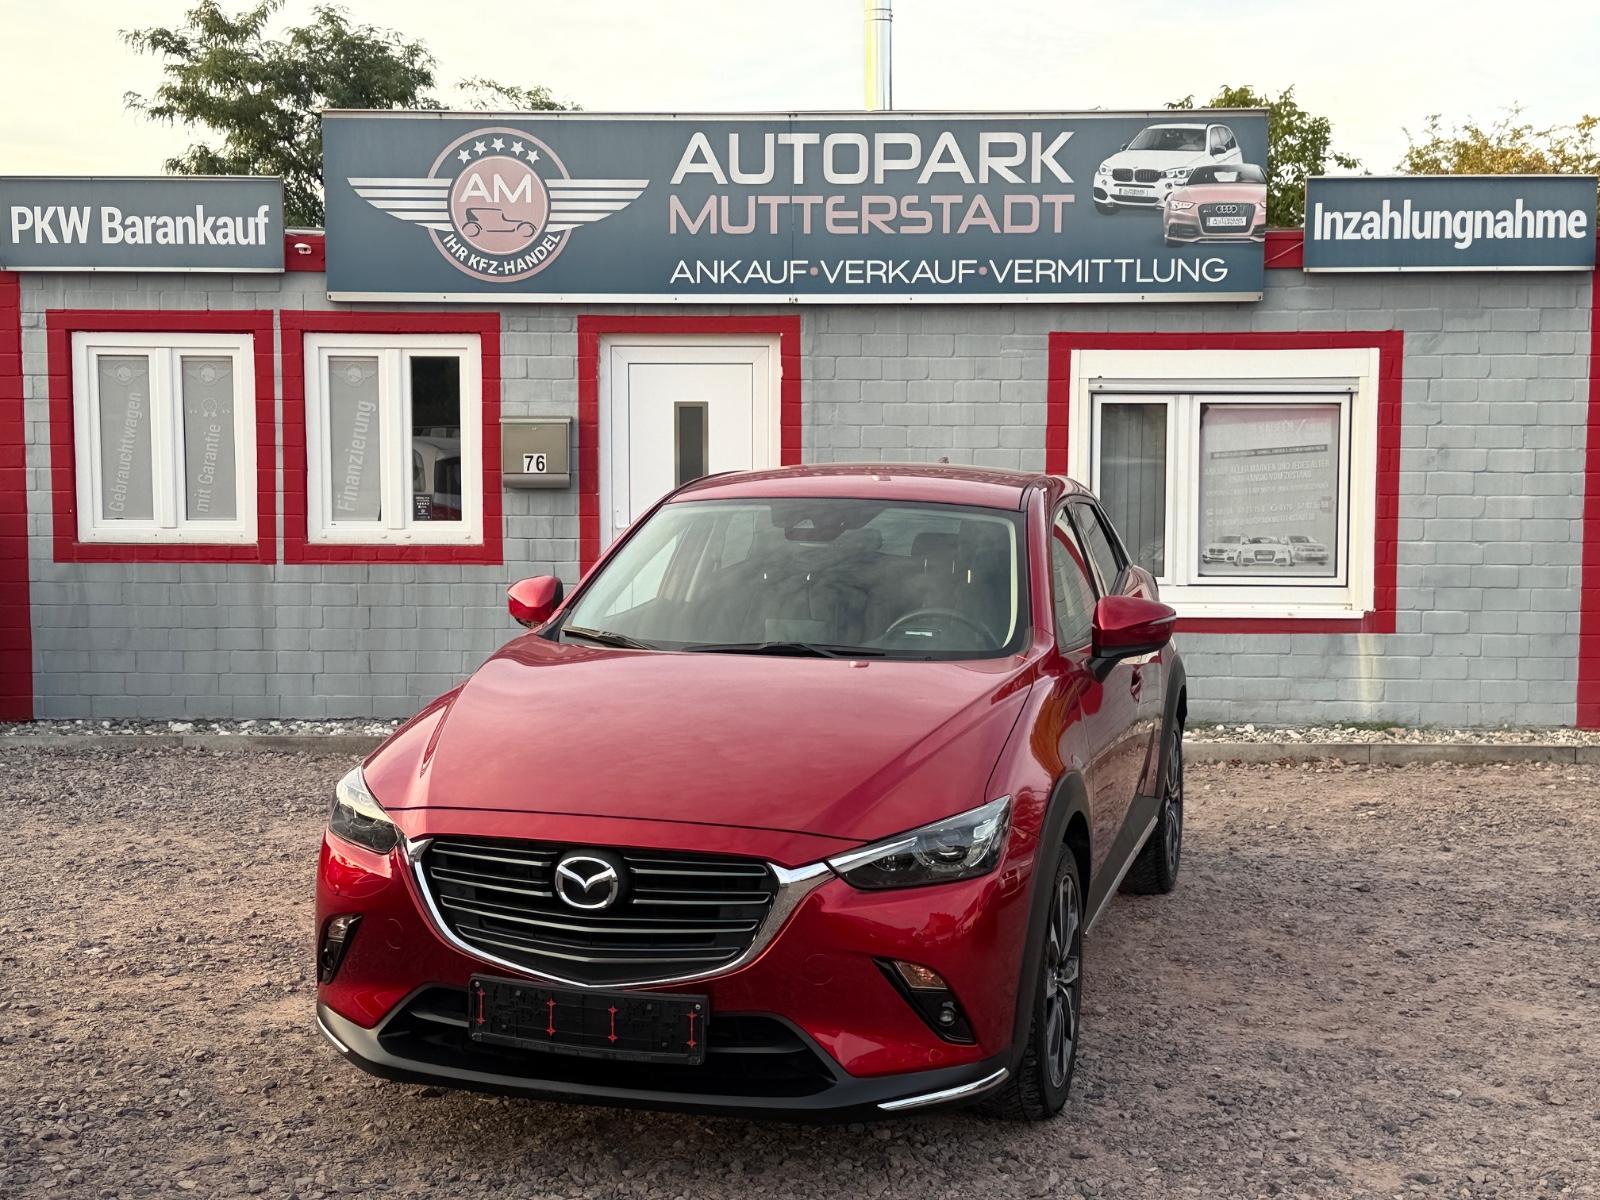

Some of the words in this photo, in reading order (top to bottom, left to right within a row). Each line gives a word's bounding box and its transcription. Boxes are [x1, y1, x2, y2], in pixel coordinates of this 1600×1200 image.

[669, 131, 1075, 185] AUTOPARK
[459, 173, 532, 203] AM
[10, 206, 91, 244] PKW
[101, 204, 269, 245] Barankauf
[669, 194, 1075, 235] MUTTERSTADT
[1313, 198, 1587, 250] Inzahlungnahme
[443, 233, 469, 261] IHR
[467, 234, 561, 275] KFZ-HANDEL
[669, 260, 809, 284] ANKAUF
[820, 259, 978, 284] VERKAUF
[989, 257, 1228, 284] VERMITTLUNG
[108, 392, 143, 512] Gebrauchtwagen
[197, 423, 221, 484] Garantie
[337, 399, 376, 512] Finanzierung
[524, 455, 546, 472] 76
[194, 485, 209, 512] mit
